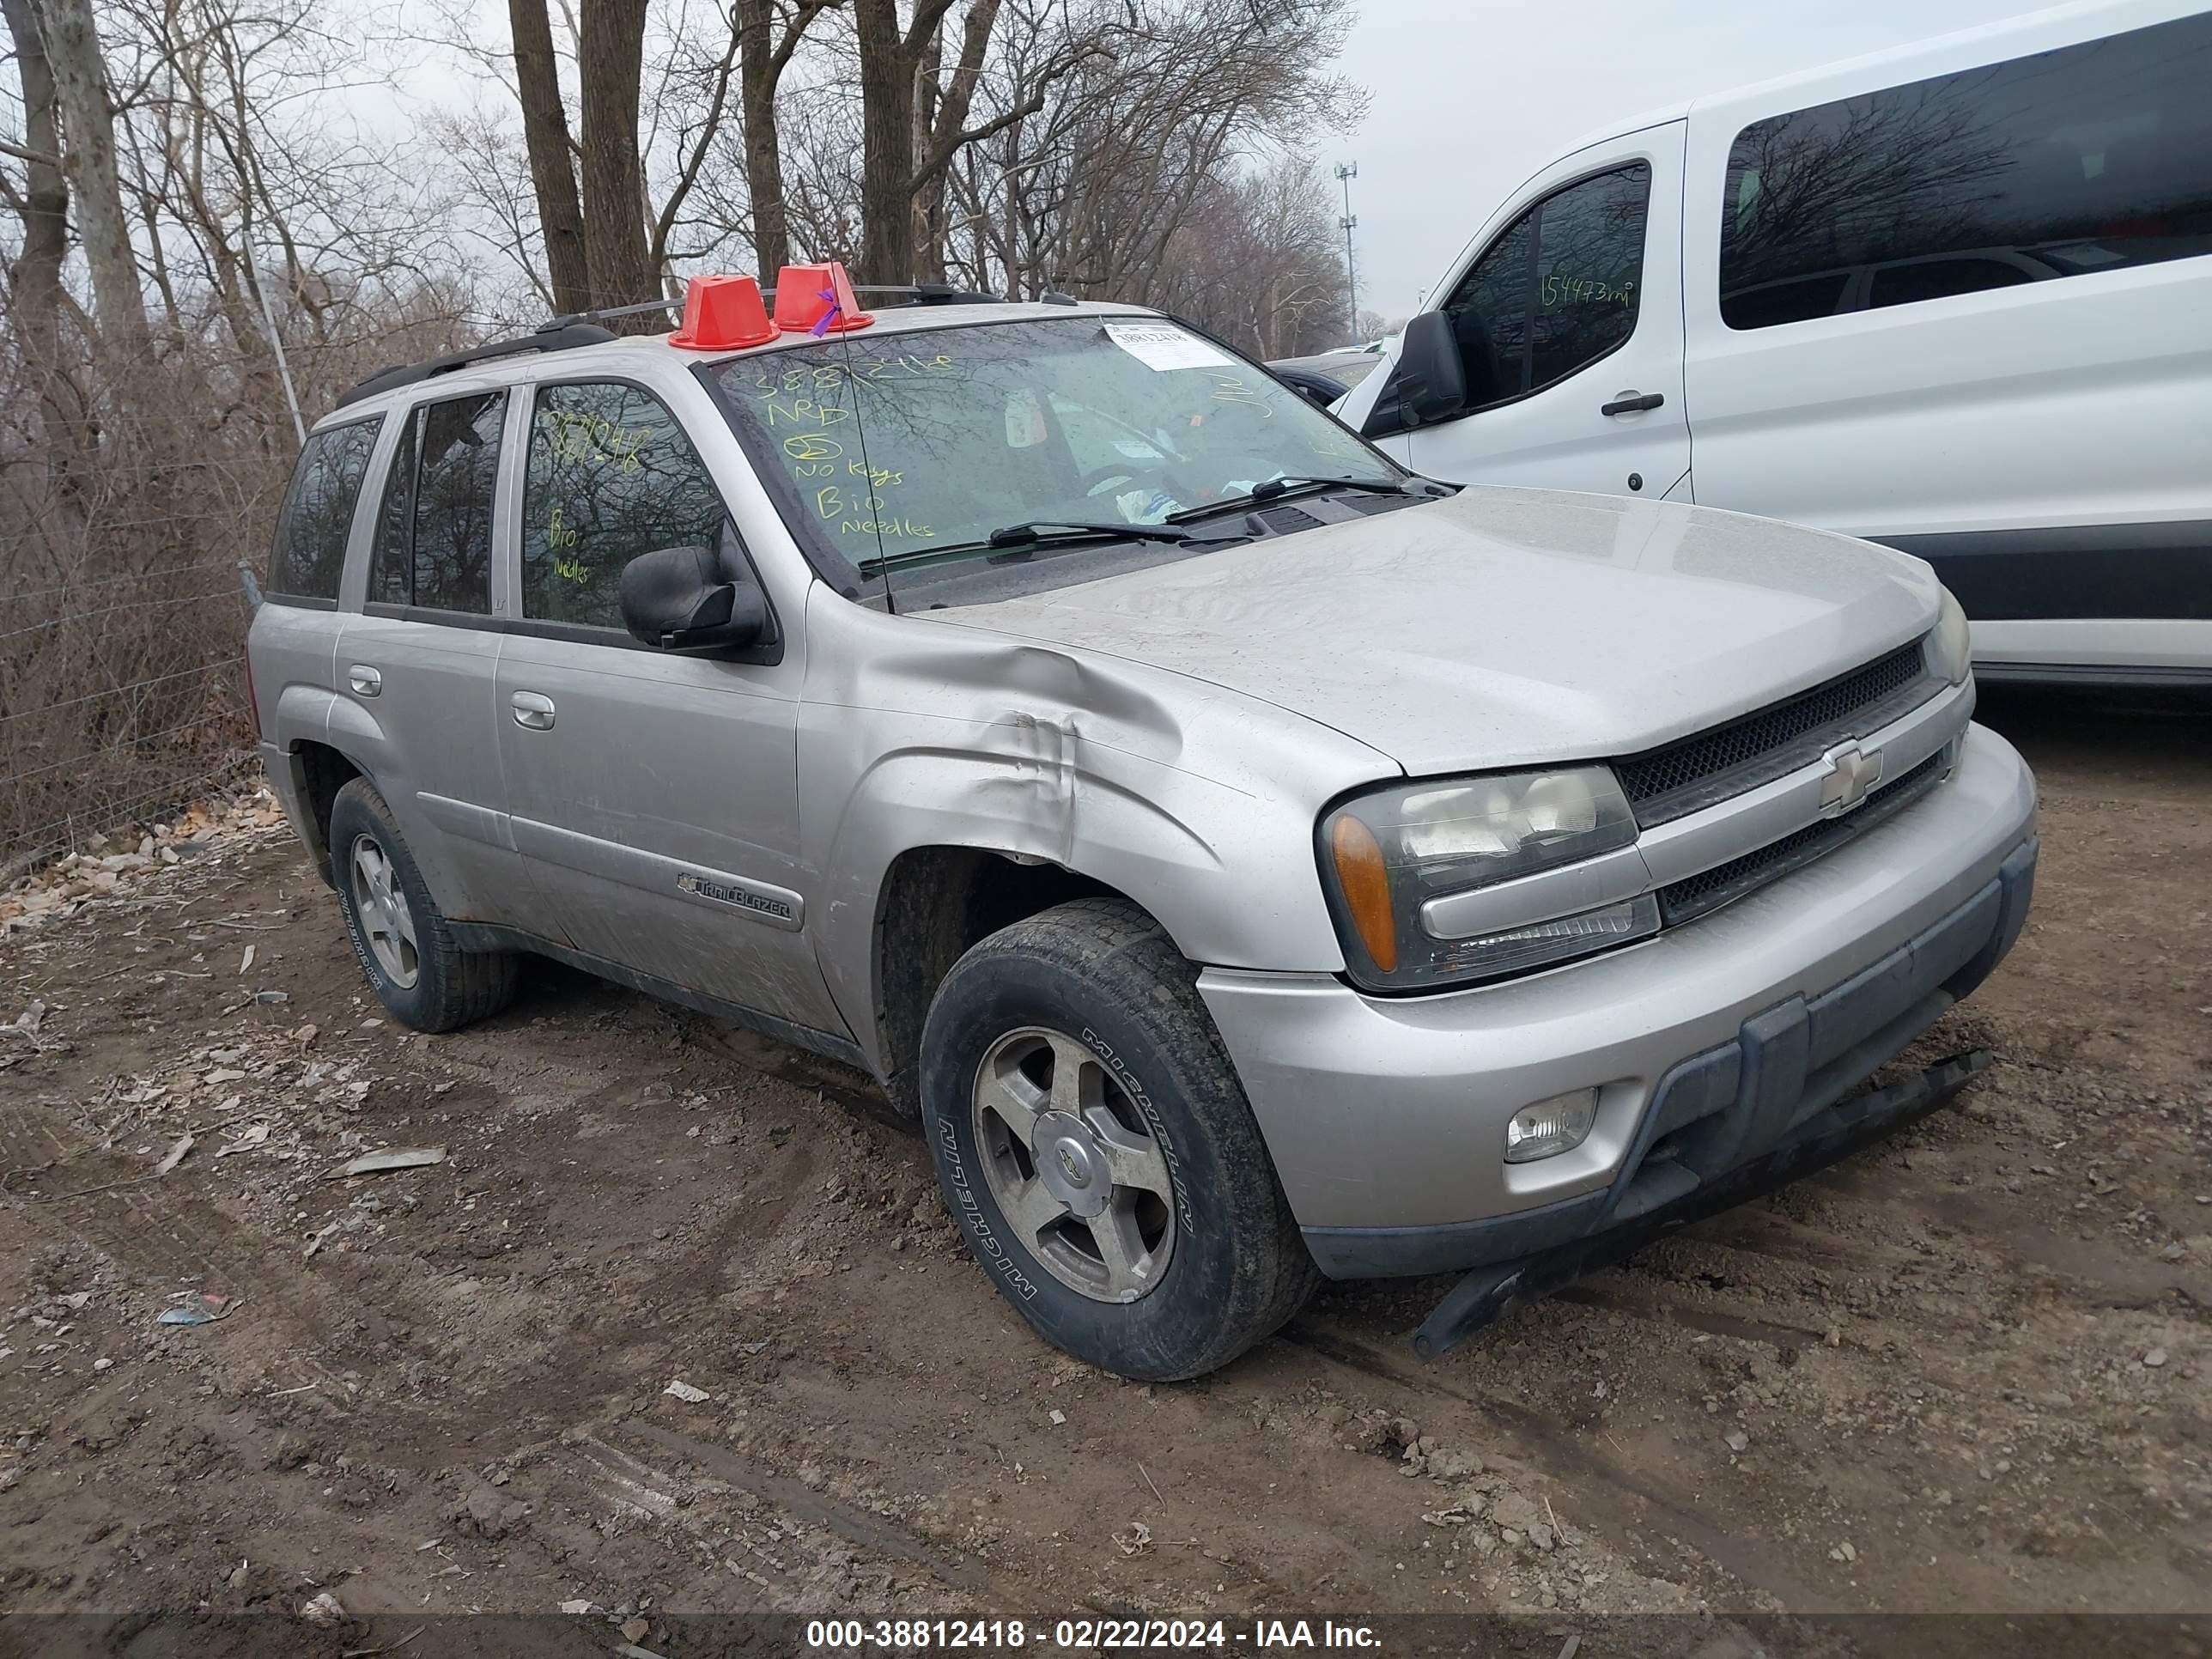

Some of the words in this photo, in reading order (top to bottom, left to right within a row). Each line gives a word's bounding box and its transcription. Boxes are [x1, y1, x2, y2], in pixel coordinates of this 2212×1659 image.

[755, 355, 952, 399] 38812418
[768, 399, 849, 427] NRD
[1082, 1027, 1194, 1233] MICHELIN
[938, 1116, 1037, 1301] MICHELIN
